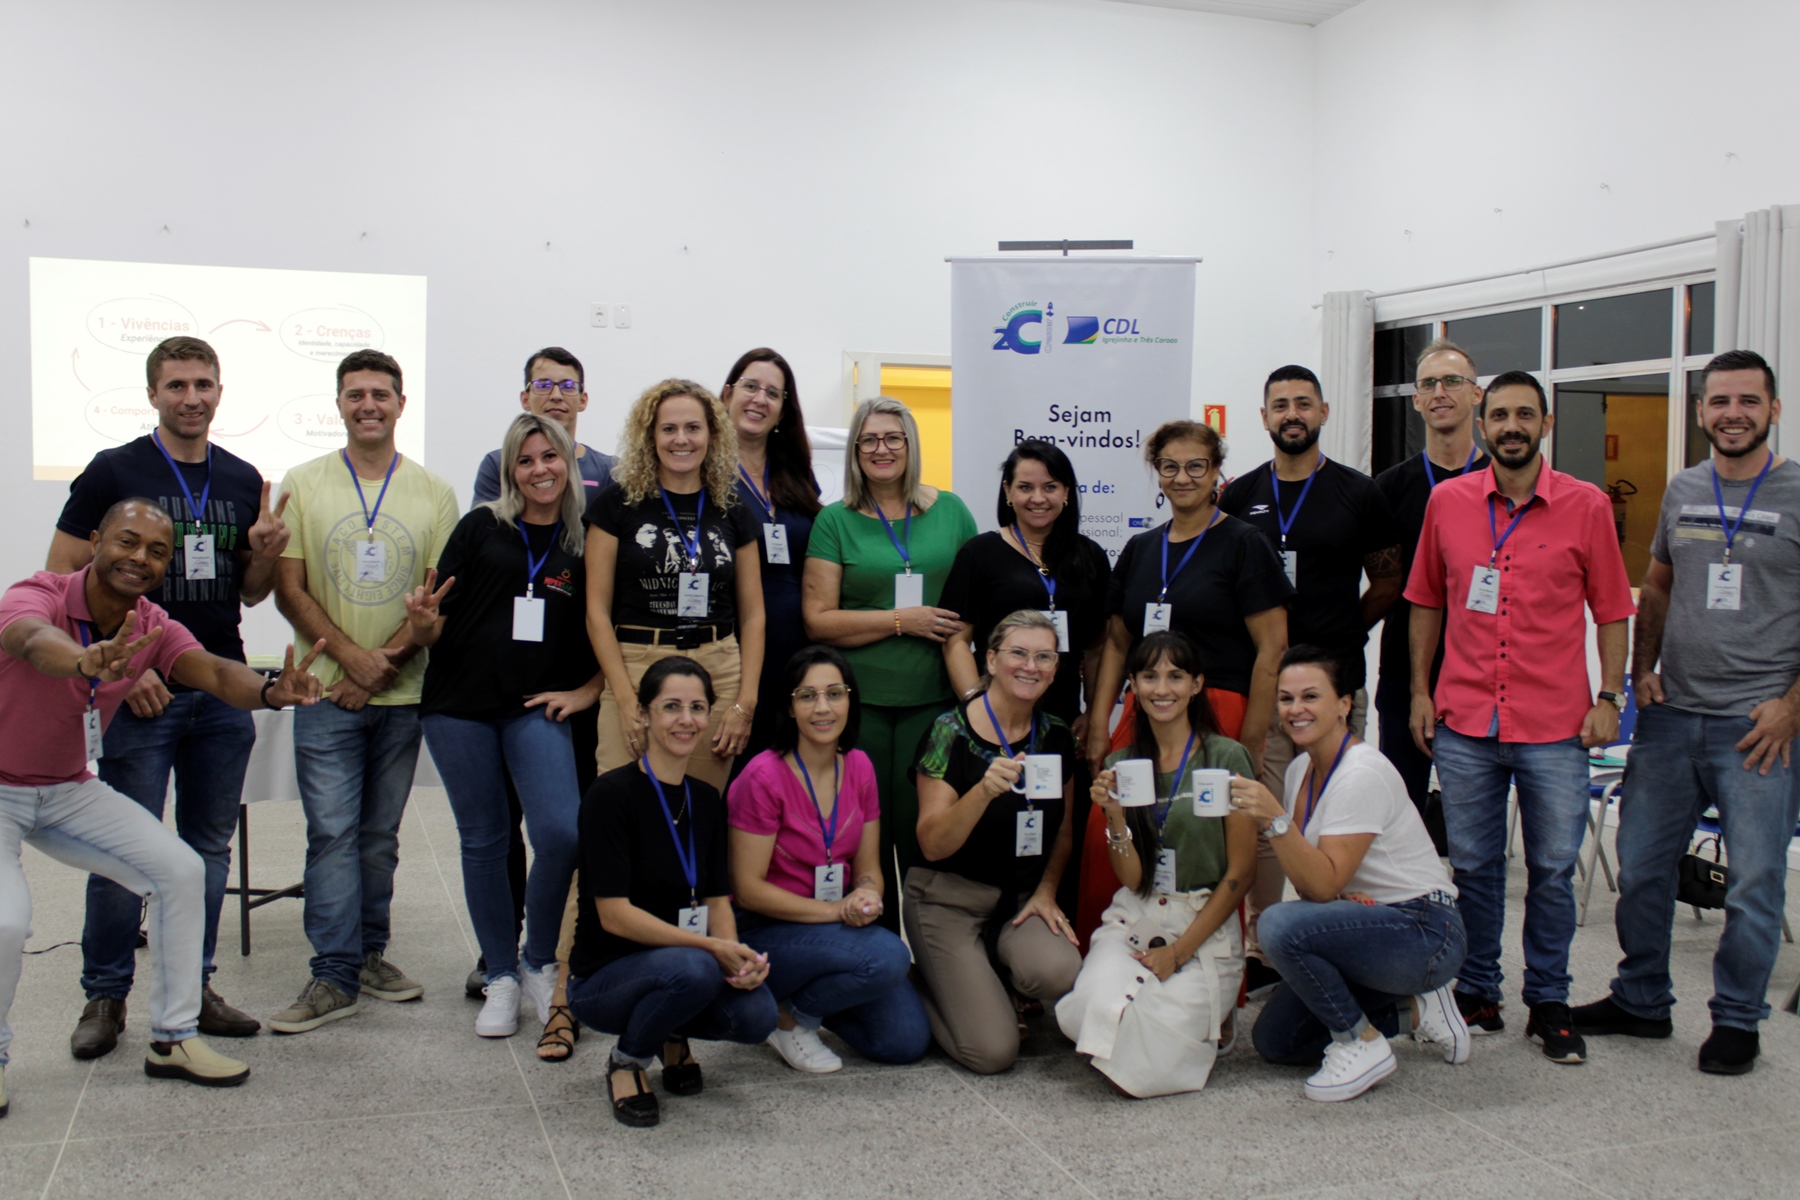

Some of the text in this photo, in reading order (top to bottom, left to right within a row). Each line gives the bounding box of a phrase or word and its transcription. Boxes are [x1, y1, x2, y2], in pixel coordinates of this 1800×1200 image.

[1002, 300, 1038, 322] Construir
[97, 316, 105, 329] 1
[121, 316, 190, 332] Vivências
[294, 324, 303, 336] 2
[316, 325, 371, 340] Crenças
[1103, 318, 1140, 335] CDL
[93, 405, 100, 414] 4
[1048, 404, 1112, 428] Sejam
[294, 413, 303, 425] 3
[1092, 480, 1115, 494] de:
